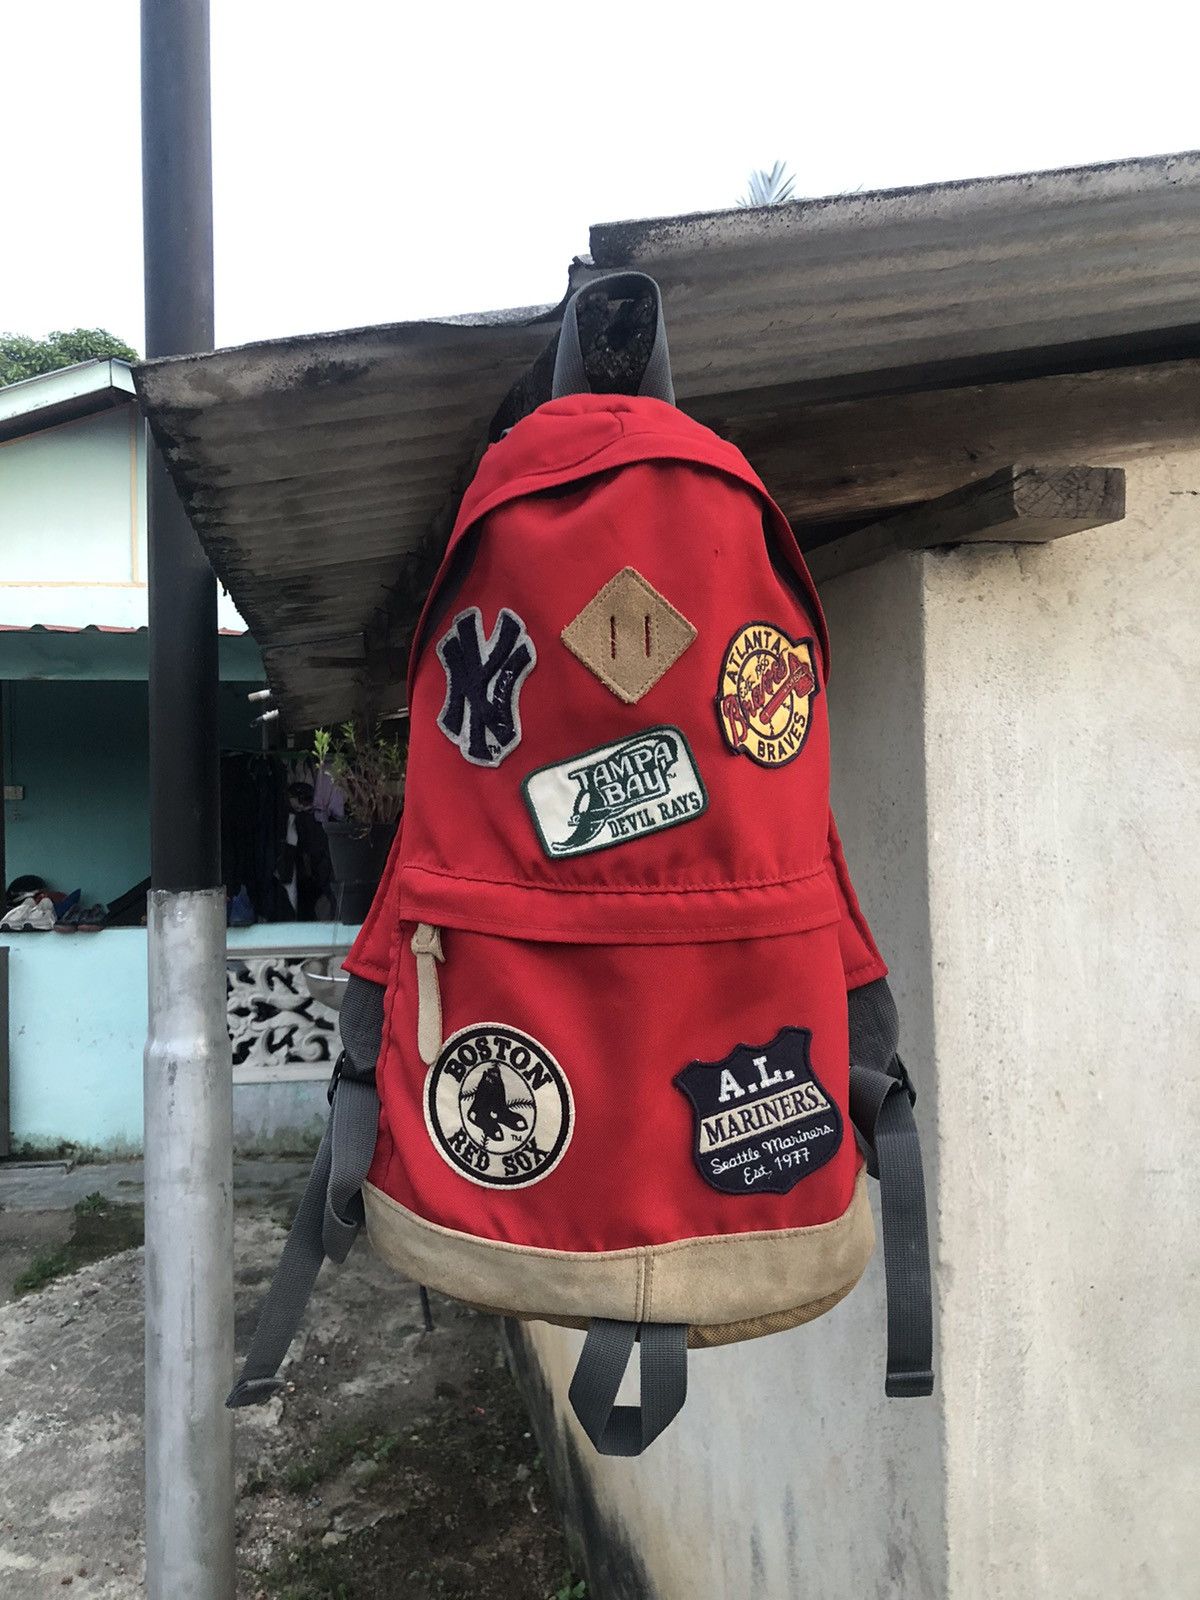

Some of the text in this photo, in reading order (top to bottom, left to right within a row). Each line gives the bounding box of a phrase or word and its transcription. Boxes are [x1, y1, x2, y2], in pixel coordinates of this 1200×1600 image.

[727, 630, 785, 686] ATLANTA
[757, 711, 806, 761] BRAVES
[569, 740, 675, 790] TAMPA
[601, 767, 667, 807] BAY
[608, 791, 701, 838] DEVIL RAYS
[444, 1036, 554, 1091] BOSTON
[718, 1055, 796, 1103] A.L.
[703, 1085, 821, 1147] MARINERS
[448, 1127, 551, 1176] RED SOX
[710, 1124, 834, 1175] Seattle Mariners
[774, 1147, 811, 1172] 1977
